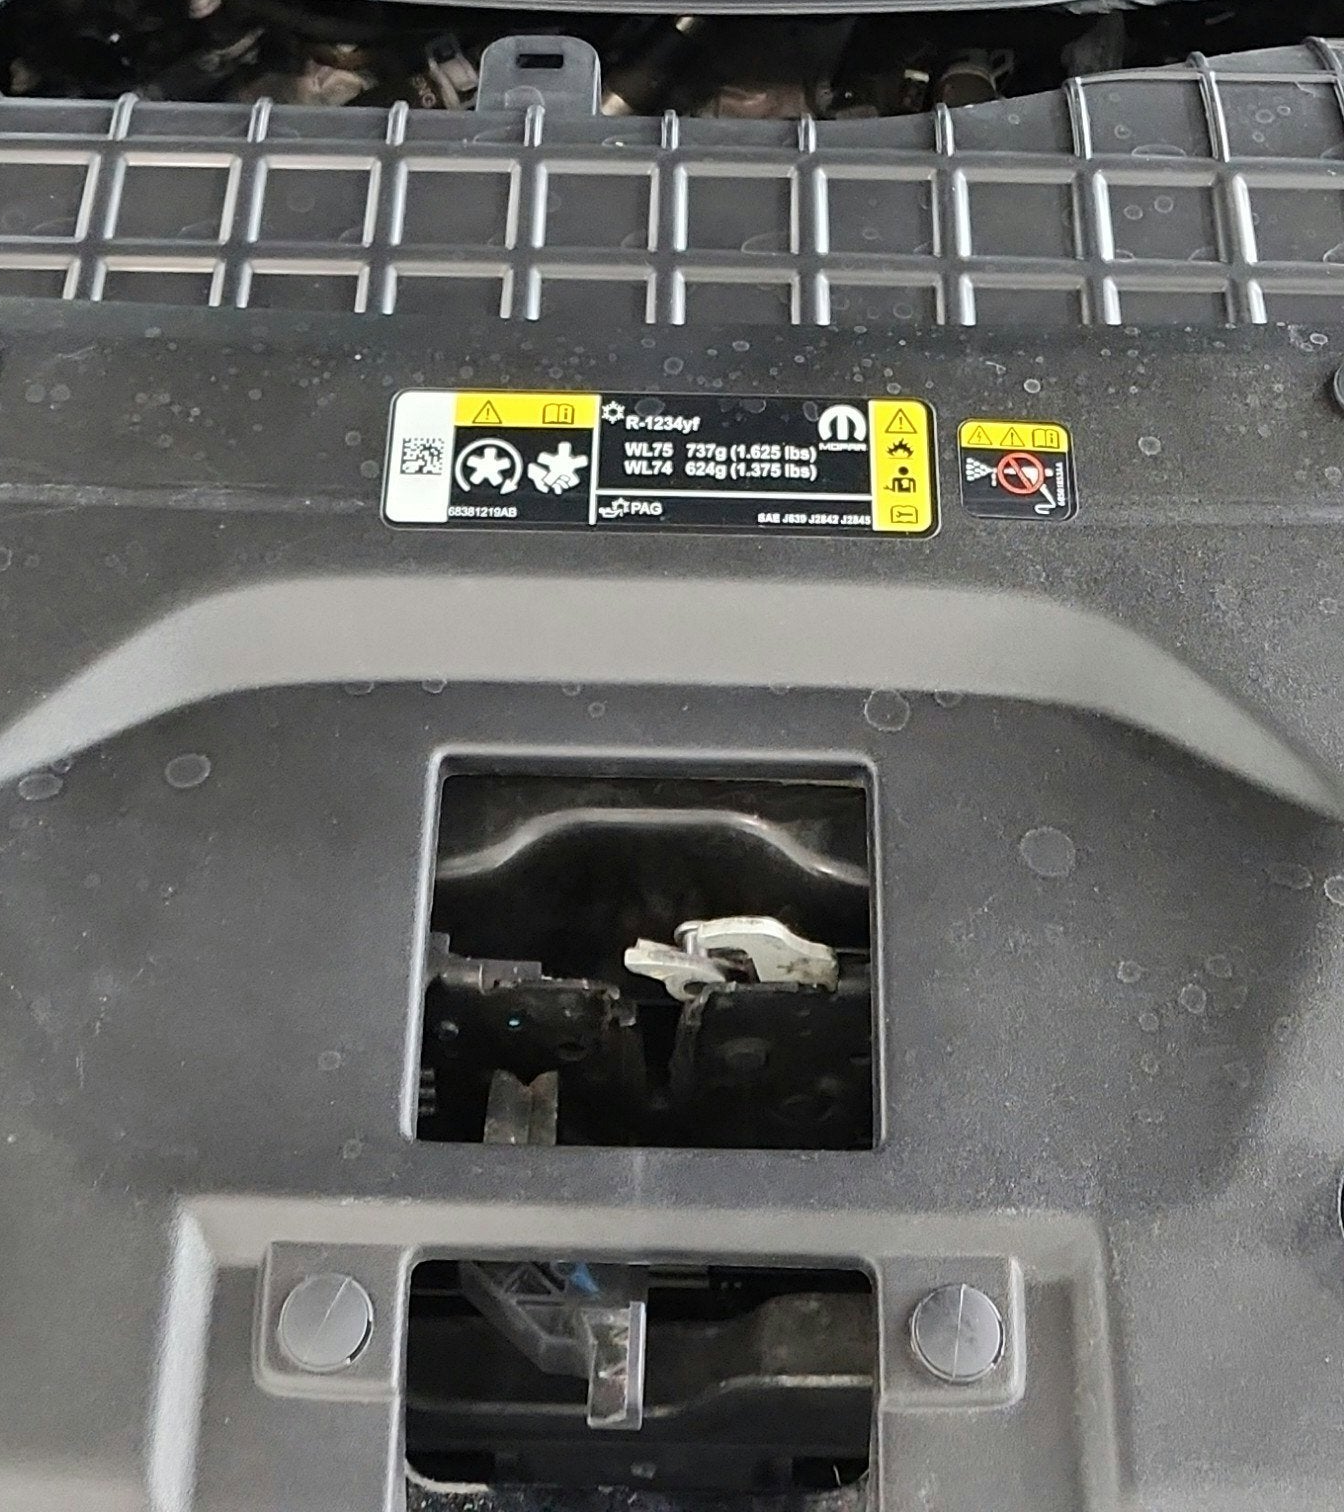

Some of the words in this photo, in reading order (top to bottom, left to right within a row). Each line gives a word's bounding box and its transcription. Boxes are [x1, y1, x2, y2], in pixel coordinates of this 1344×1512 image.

[625, 415, 700, 434] R-1234yf
[624, 442, 674, 457] WL75
[685, 443, 727, 461] 737g
[730, 444, 781, 461] (1.625
[784, 445, 817, 463] lbs)
[624, 460, 673, 475] WL74
[685, 462, 727, 479] 624g
[730, 462, 781, 479] (1.375
[784, 463, 817, 481] lbs)
[630, 501, 663, 516] PAG
[757, 513, 781, 524] SAE
